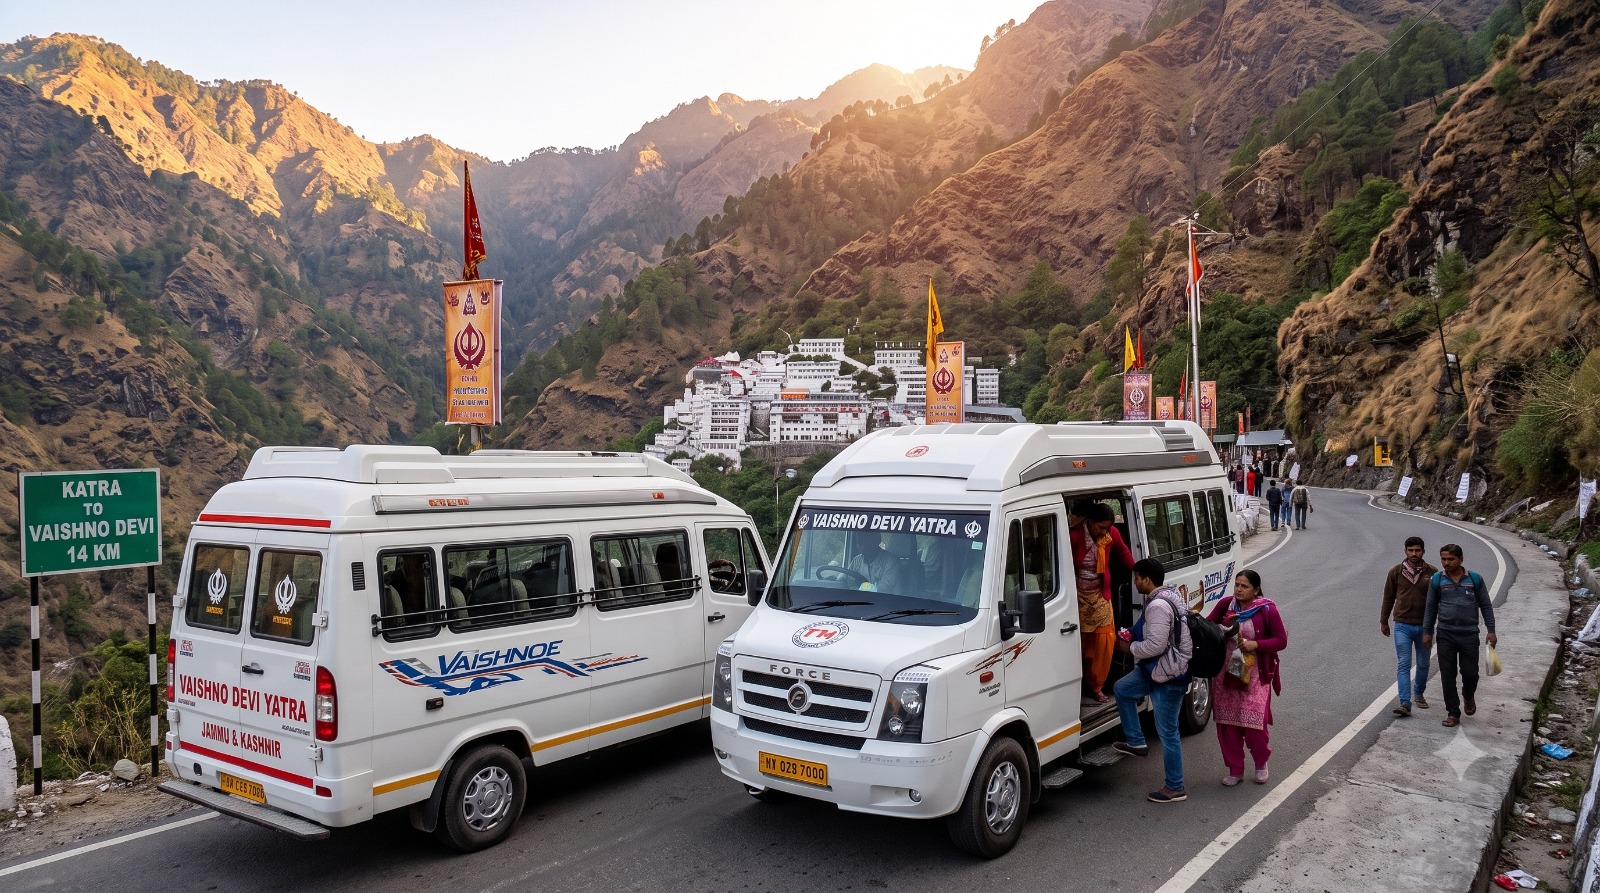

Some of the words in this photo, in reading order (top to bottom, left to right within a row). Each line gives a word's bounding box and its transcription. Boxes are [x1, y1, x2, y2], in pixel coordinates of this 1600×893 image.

[62, 480, 122, 498] KATRA
[83, 502, 103, 516] TO
[29, 520, 110, 542] VAISHNO
[115, 517, 155, 536] DEVI
[812, 512, 869, 529] VAISHNO
[870, 515, 905, 531] DEVI
[909, 516, 957, 535] YATRA
[67, 545, 89, 563] 14
[93, 542, 121, 561] KM
[438, 639, 564, 675] VAISHNOE
[769, 664, 831, 681] FORCE
[179, 674, 229, 705] VAISHNO
[232, 685, 261, 713] DEVI
[263, 692, 308, 724] YATRA
[201, 721, 230, 745] JAMMU
[232, 729, 239, 747] &
[800, 765, 824, 780] 7000
